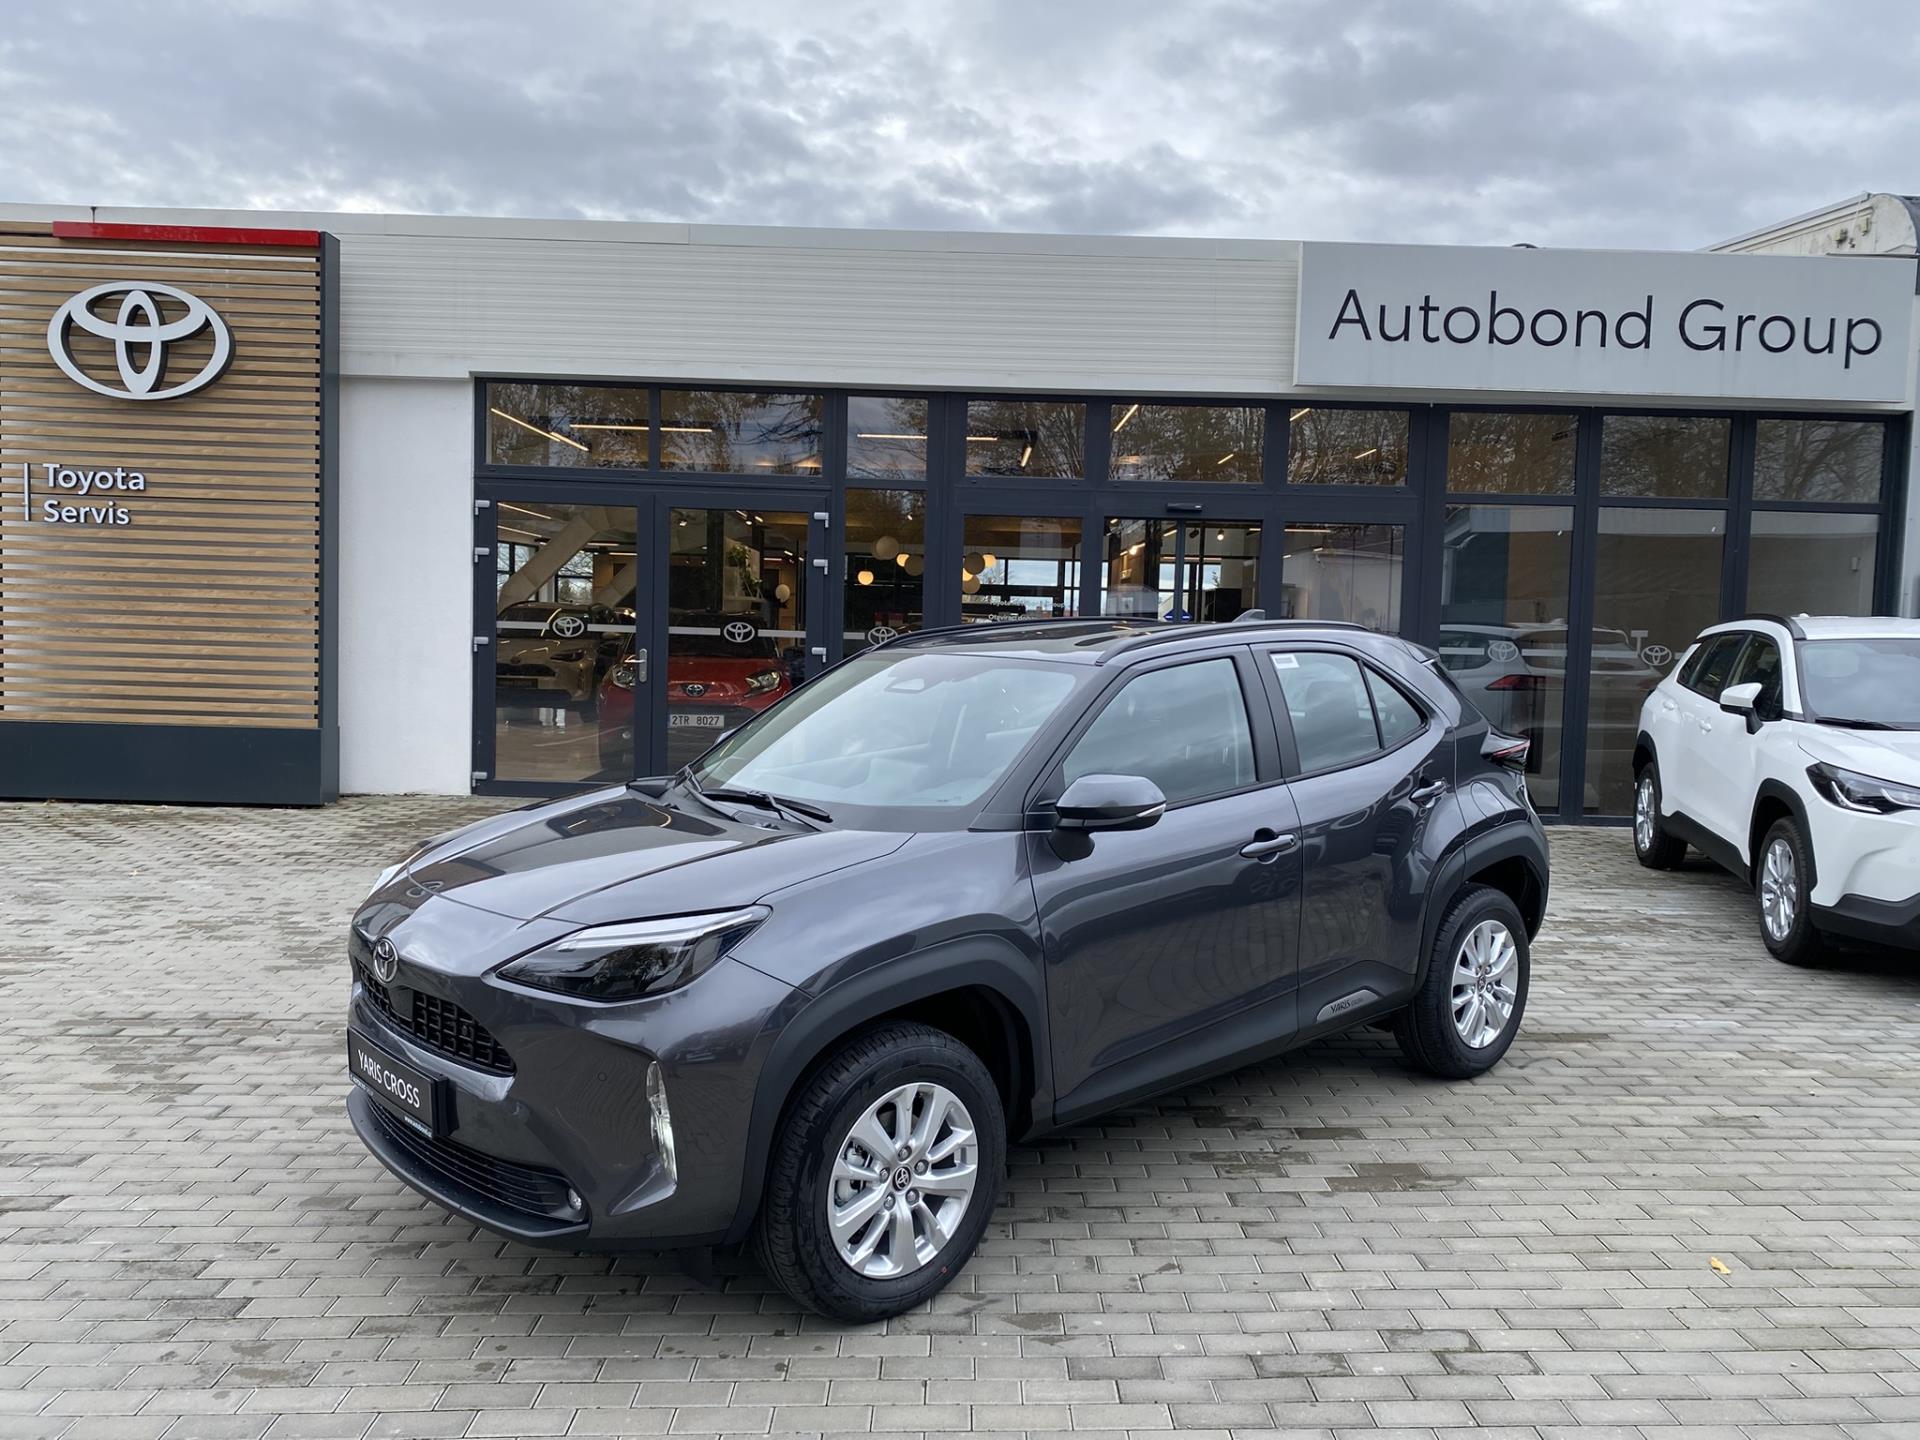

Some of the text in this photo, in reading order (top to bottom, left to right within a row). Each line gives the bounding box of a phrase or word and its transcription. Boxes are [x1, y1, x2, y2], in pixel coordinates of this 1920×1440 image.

[1329, 289, 1882, 370] Autobond Group
[43, 463, 145, 495] Toyota
[43, 499, 131, 525] Servis
[672, 715, 720, 726] 2TR 8027
[1330, 999, 1351, 1014] YARIS
[358, 1049, 383, 1084] YARIS
[383, 1070, 420, 1108] CROSS
